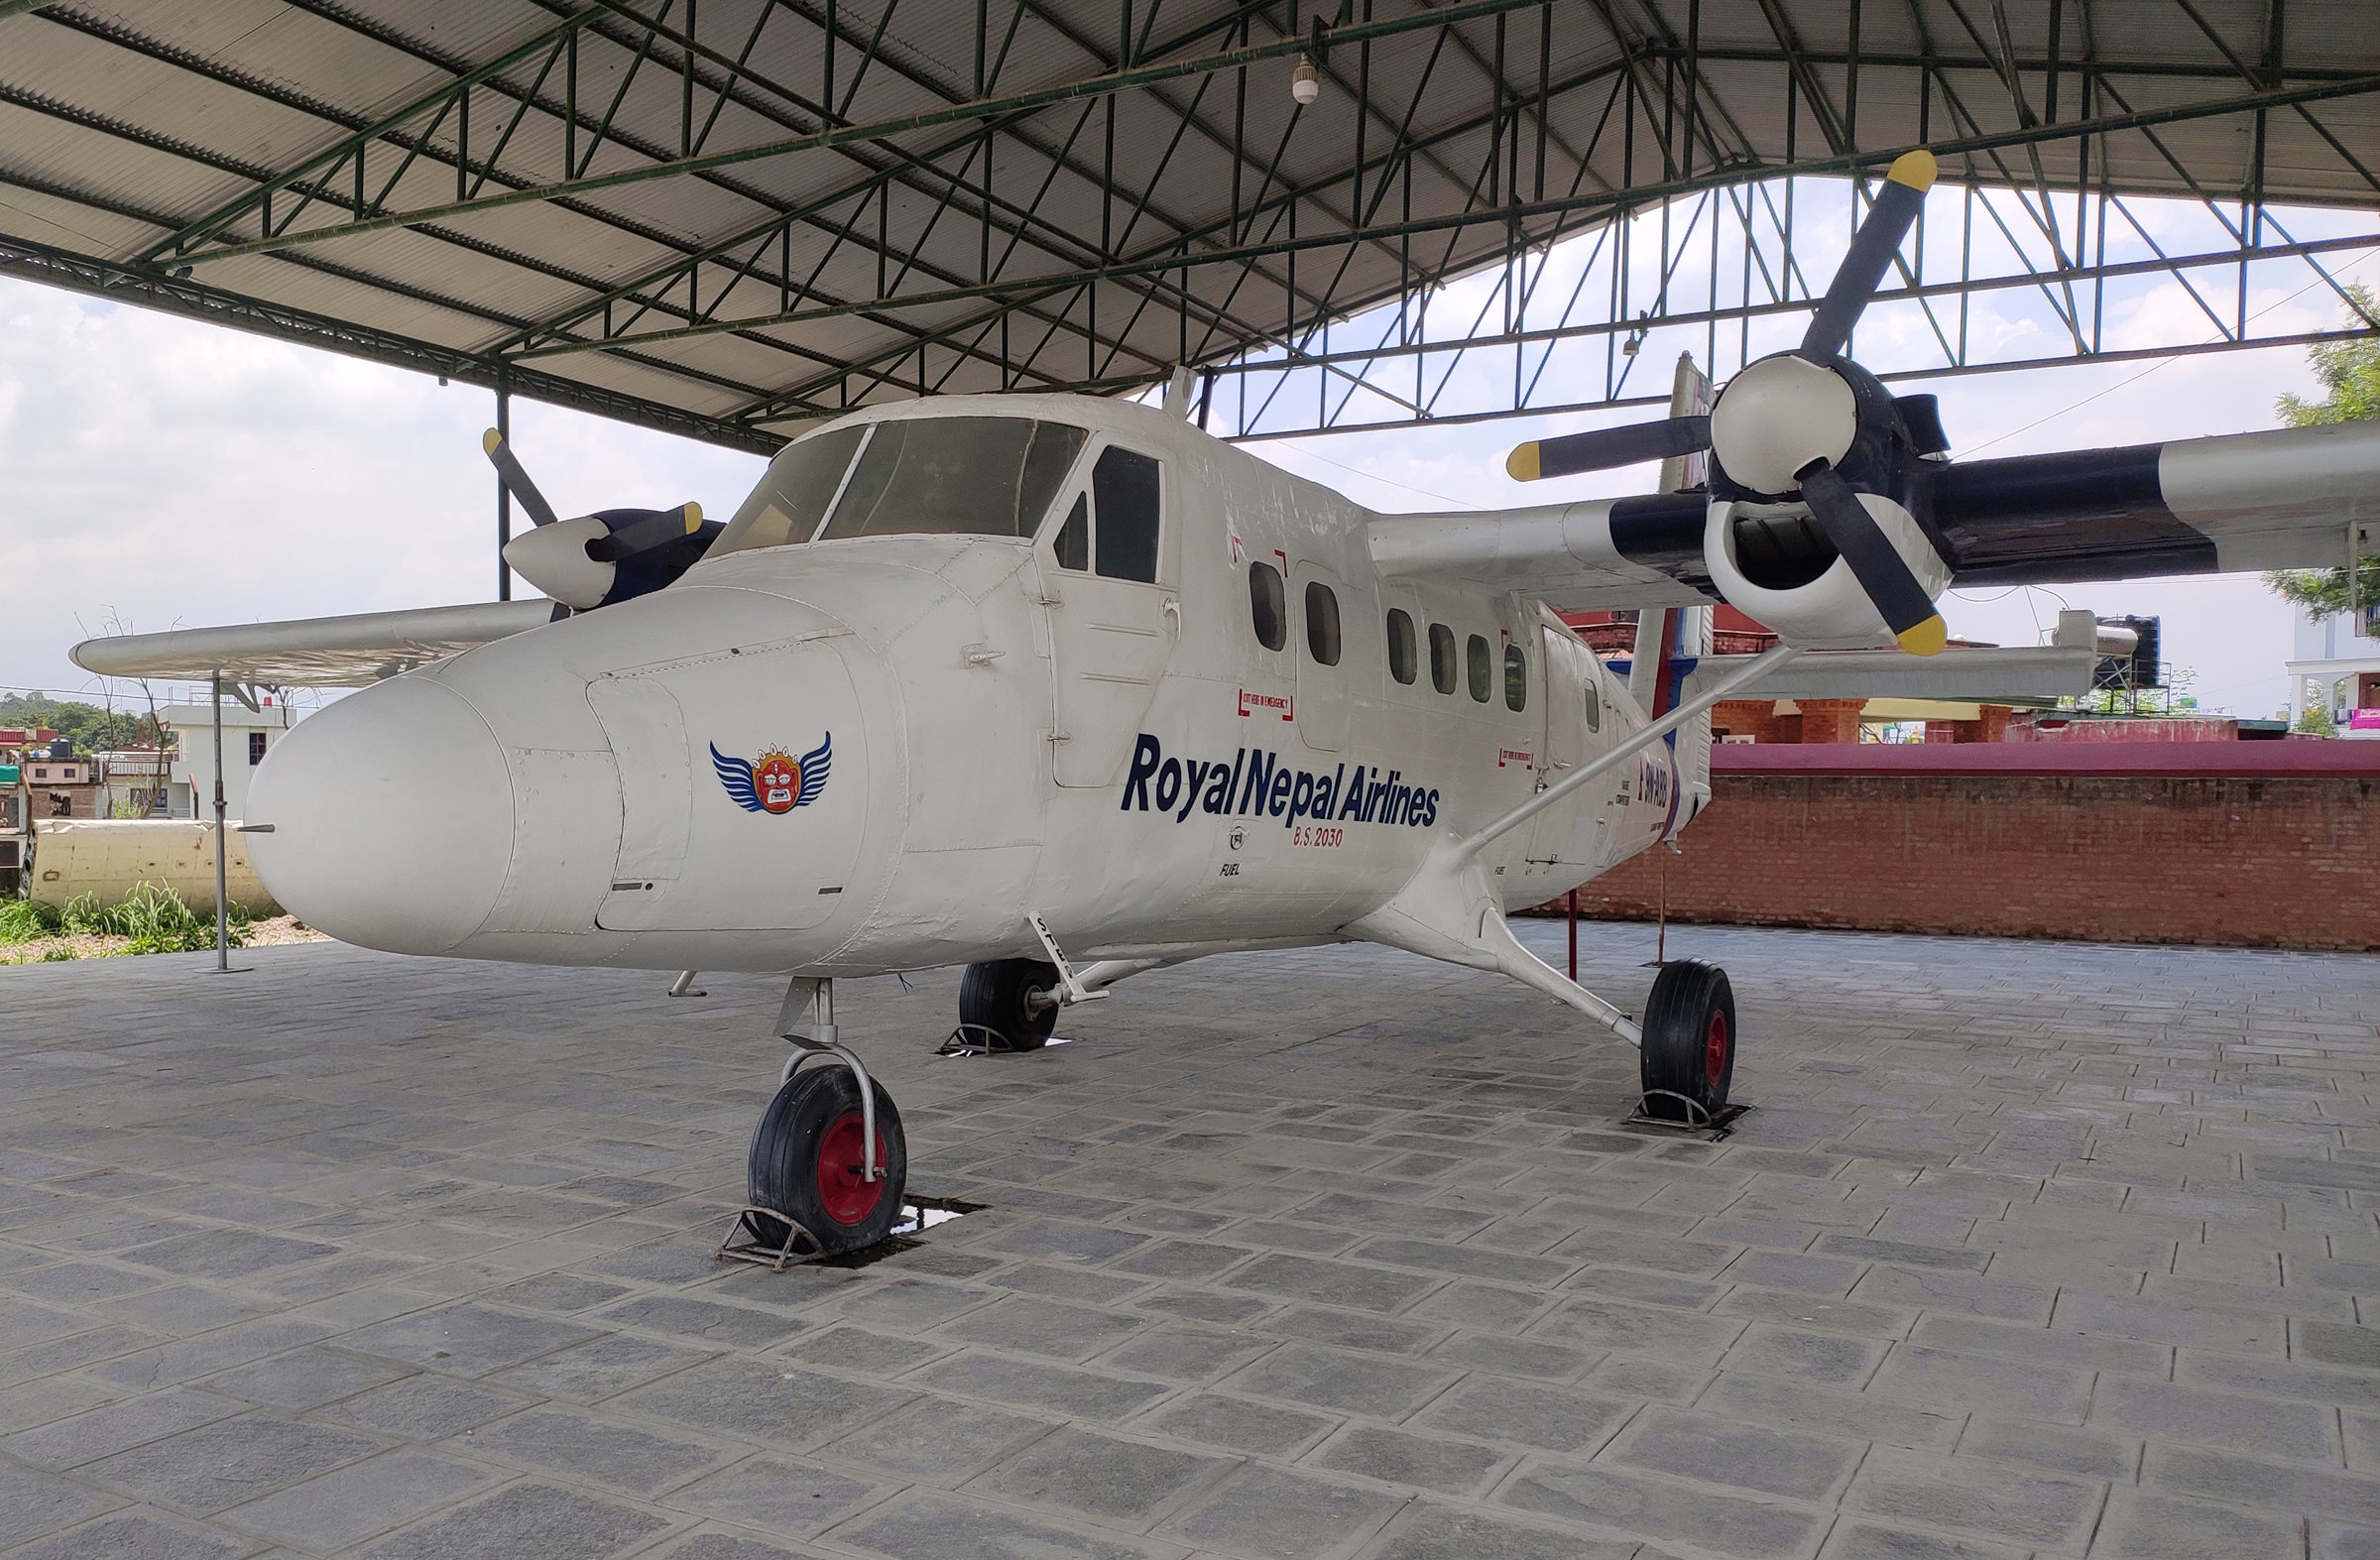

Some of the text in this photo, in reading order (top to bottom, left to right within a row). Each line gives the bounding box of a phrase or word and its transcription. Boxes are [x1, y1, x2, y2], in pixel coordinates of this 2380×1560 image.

[1121, 733, 1440, 829] Royal Nepal Airlines
[1313, 827, 1344, 848] 2030
[1219, 863, 1241, 877] FUEL
